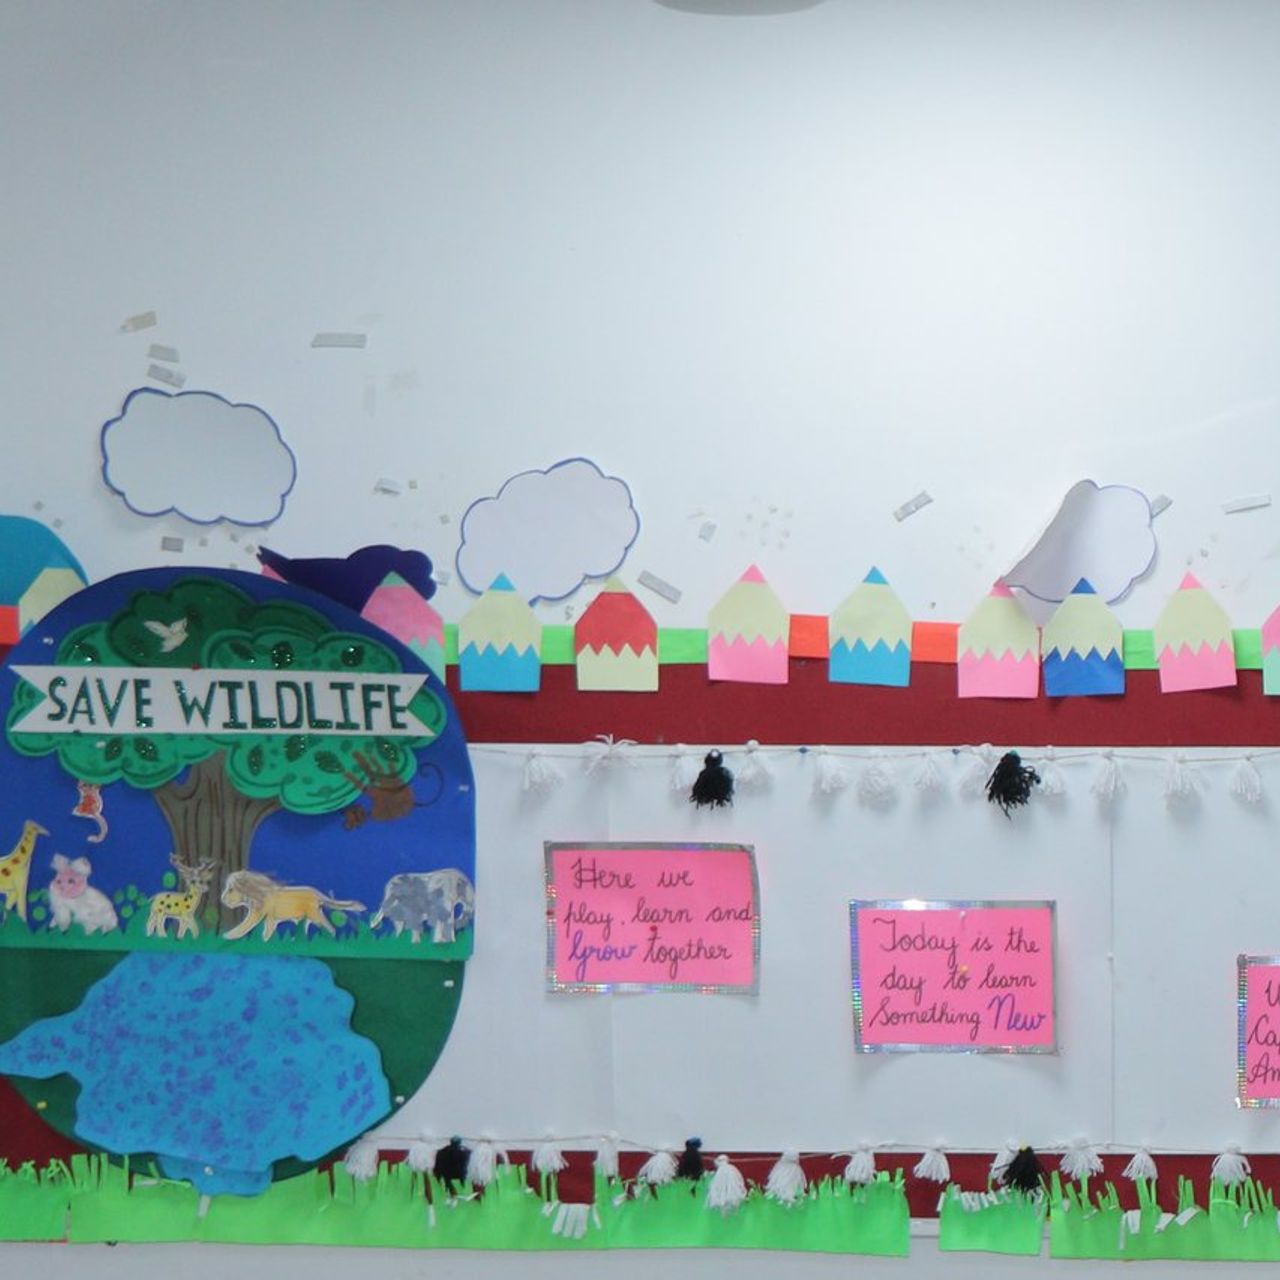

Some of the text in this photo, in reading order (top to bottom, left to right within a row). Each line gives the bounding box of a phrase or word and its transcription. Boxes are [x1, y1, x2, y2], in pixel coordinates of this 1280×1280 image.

[47, 677, 408, 731] SAVE WILDLIFE
[570, 856, 694, 889] Here we
[631, 896, 693, 923] learn
[705, 902, 753, 922] and
[872, 917, 1040, 968] Today is the
[880, 963, 1037, 1005] day to learn
[987, 993, 1046, 1031] New
